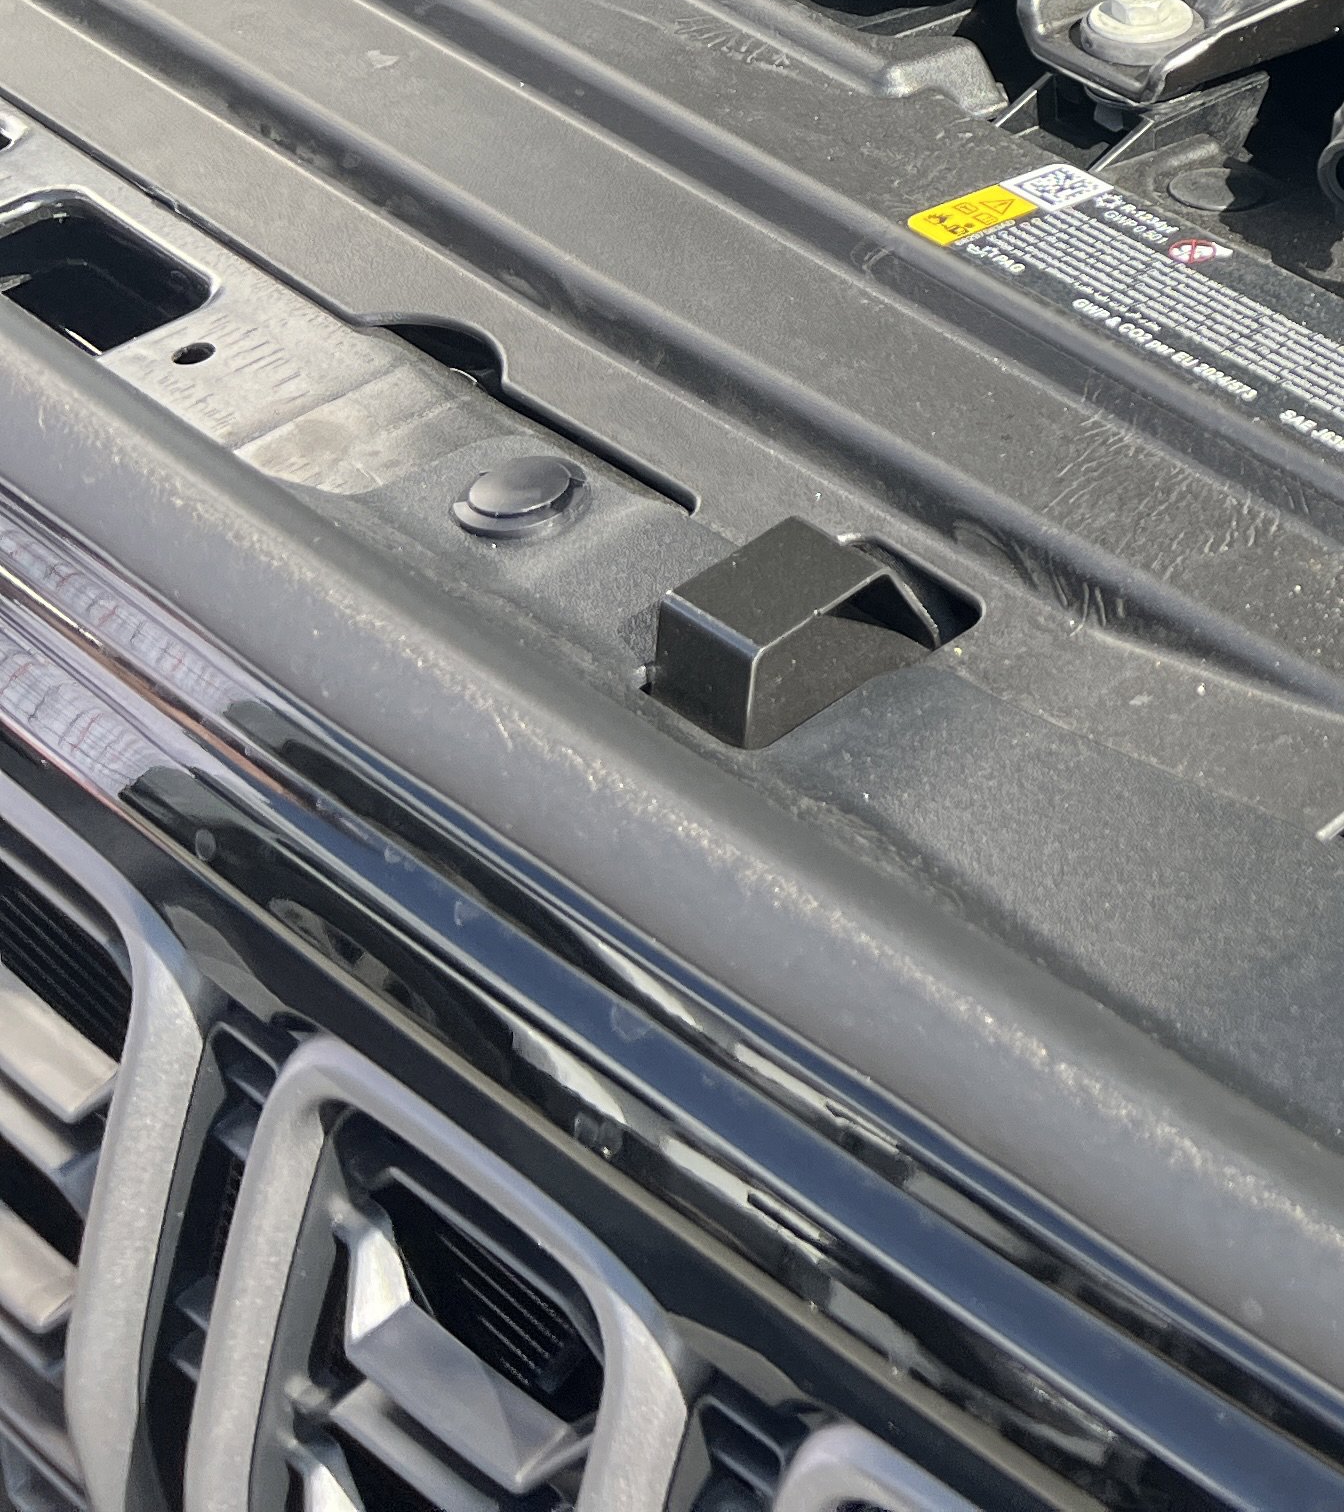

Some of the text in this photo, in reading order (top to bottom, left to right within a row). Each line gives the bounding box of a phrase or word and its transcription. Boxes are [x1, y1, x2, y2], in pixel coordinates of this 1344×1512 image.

[1103, 210, 1138, 227] GWP
[1072, 298, 1110, 320] GWP
[1118, 323, 1153, 343] CO2
[1171, 351, 1200, 368] EU
[1279, 409, 1317, 434] SAE
